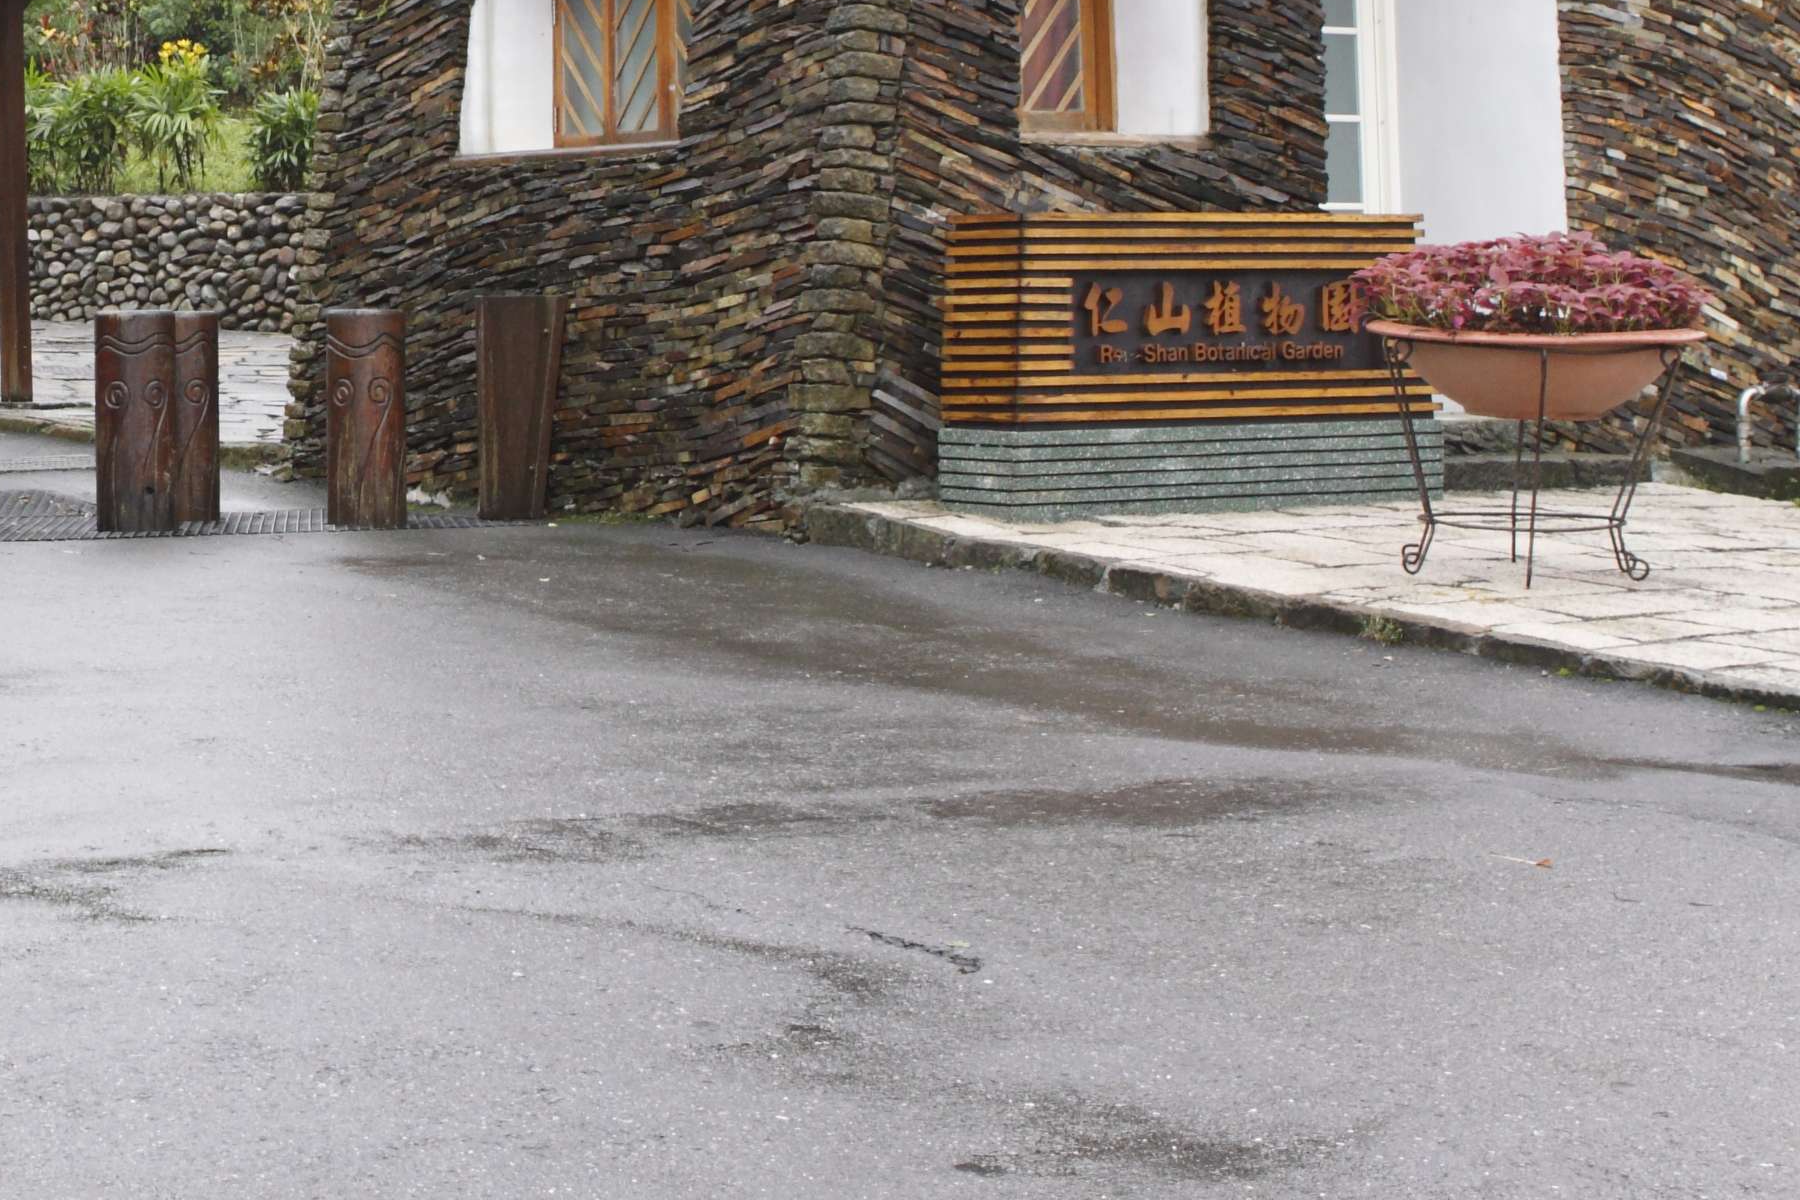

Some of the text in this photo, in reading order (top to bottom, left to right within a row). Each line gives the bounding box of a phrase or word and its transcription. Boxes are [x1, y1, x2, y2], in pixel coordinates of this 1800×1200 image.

[1084, 279, 1360, 337] 仁山植物園
[1195, 341, 1278, 362] Botanical
[1282, 340, 1345, 360] Garden
